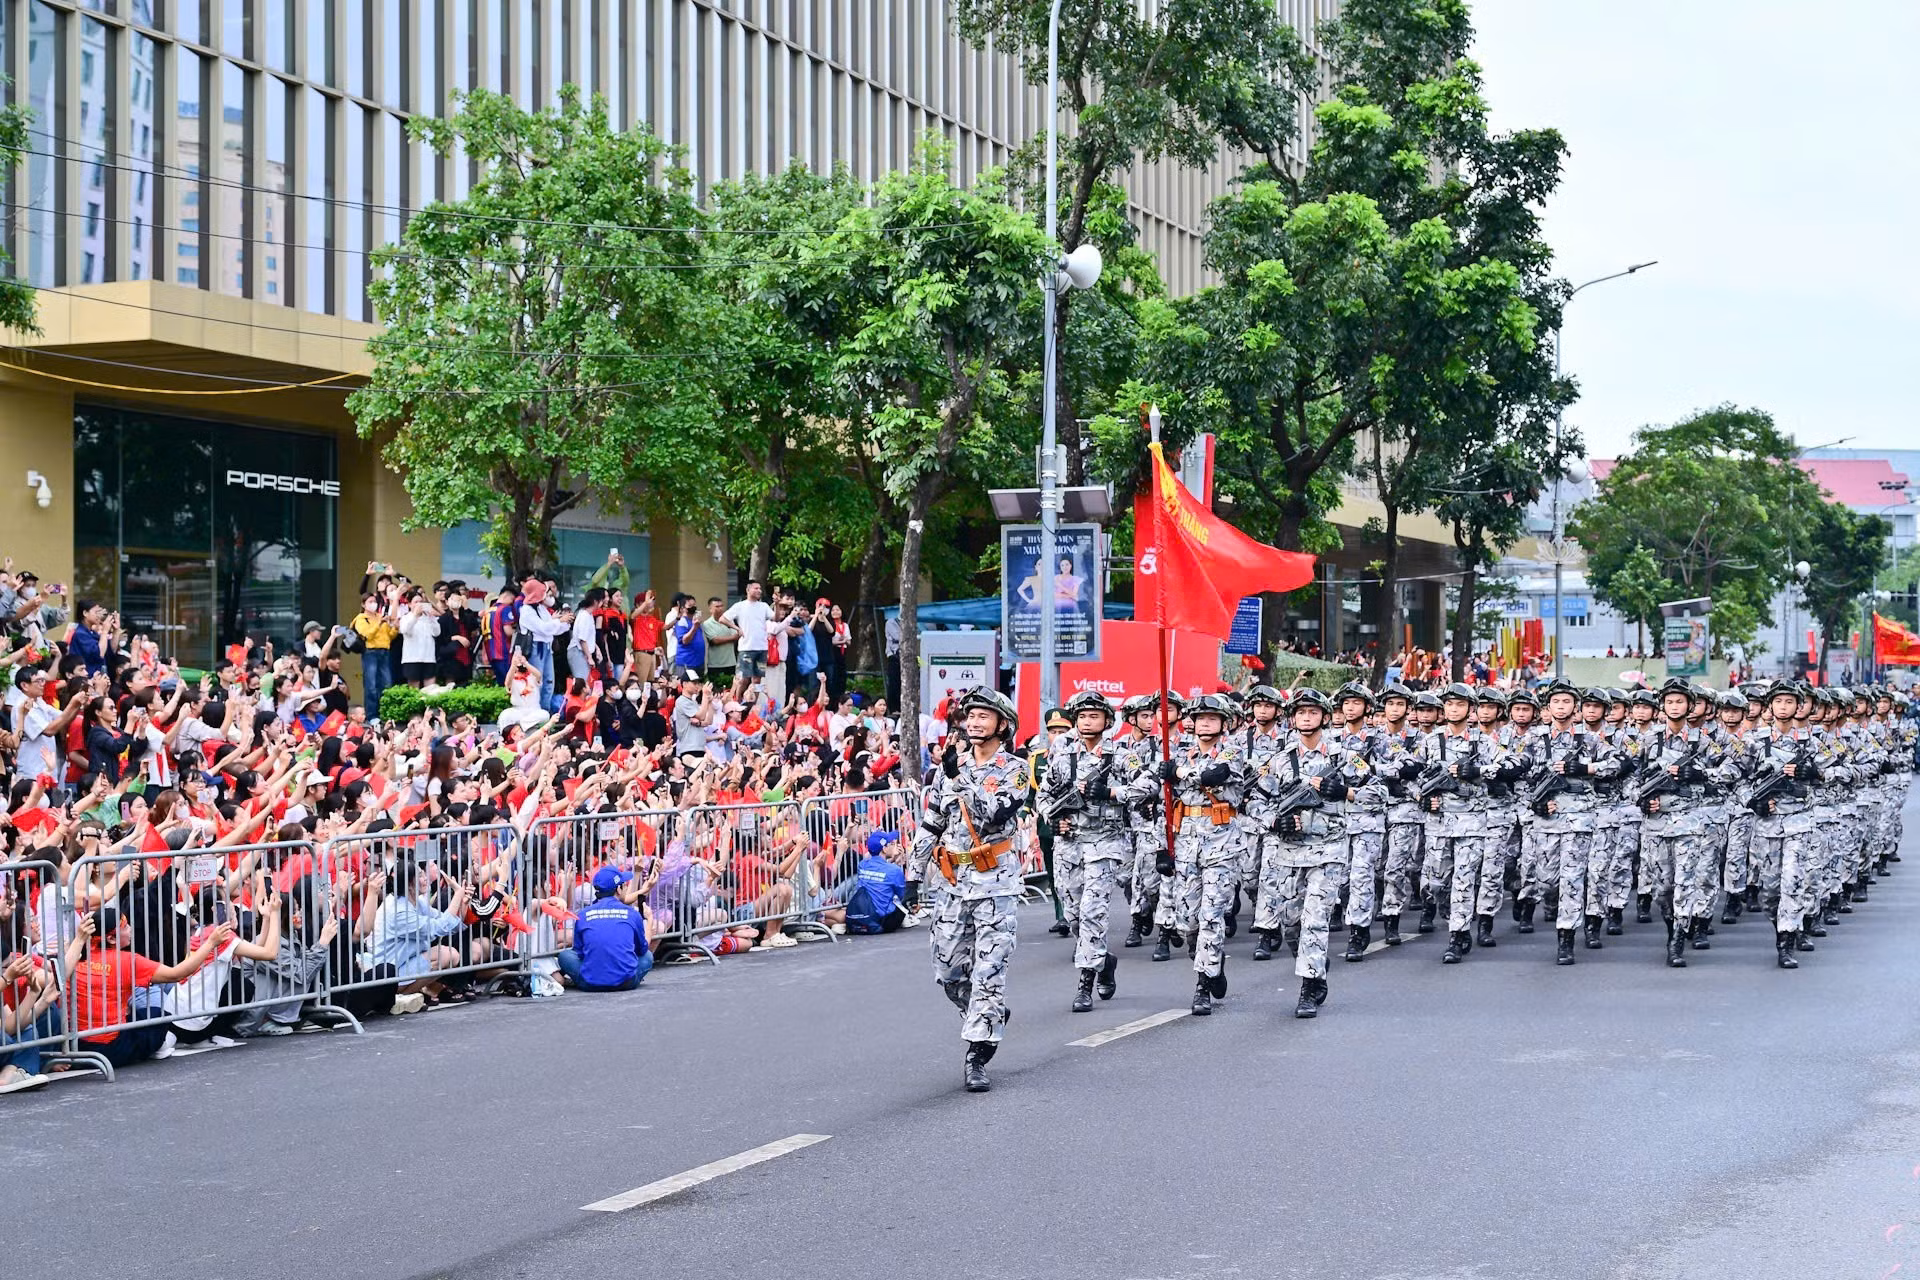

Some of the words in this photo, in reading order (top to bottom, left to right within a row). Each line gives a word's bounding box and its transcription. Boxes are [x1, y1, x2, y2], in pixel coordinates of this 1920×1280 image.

[226, 469, 340, 497] PORSCHE
[1073, 678, 1125, 694] viettel
[194, 868, 211, 878] STOP
